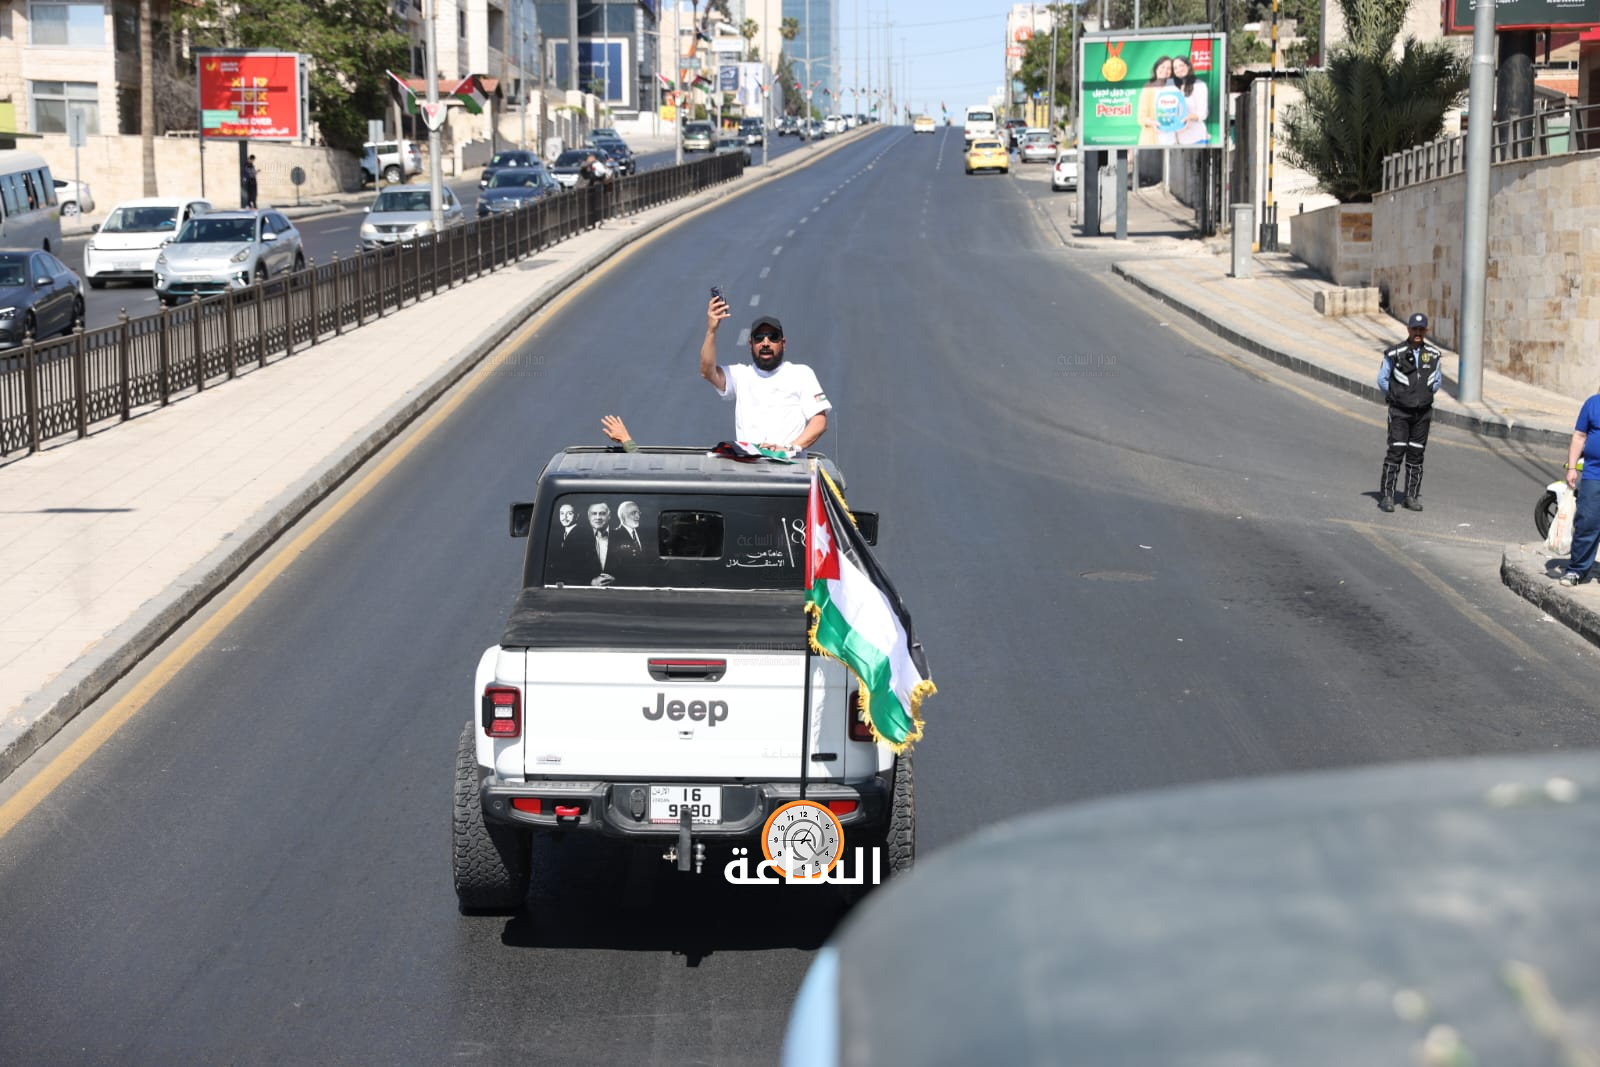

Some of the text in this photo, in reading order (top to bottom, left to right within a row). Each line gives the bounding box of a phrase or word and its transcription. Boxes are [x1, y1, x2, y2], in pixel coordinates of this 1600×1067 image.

[1096, 103, 1132, 117] Persil
[250, 118, 272, 126] OVER
[791, 518, 806, 547] 8
[642, 693, 729, 727] Jeep
[684, 788, 701, 802] 16
[669, 804, 711, 817] 990
